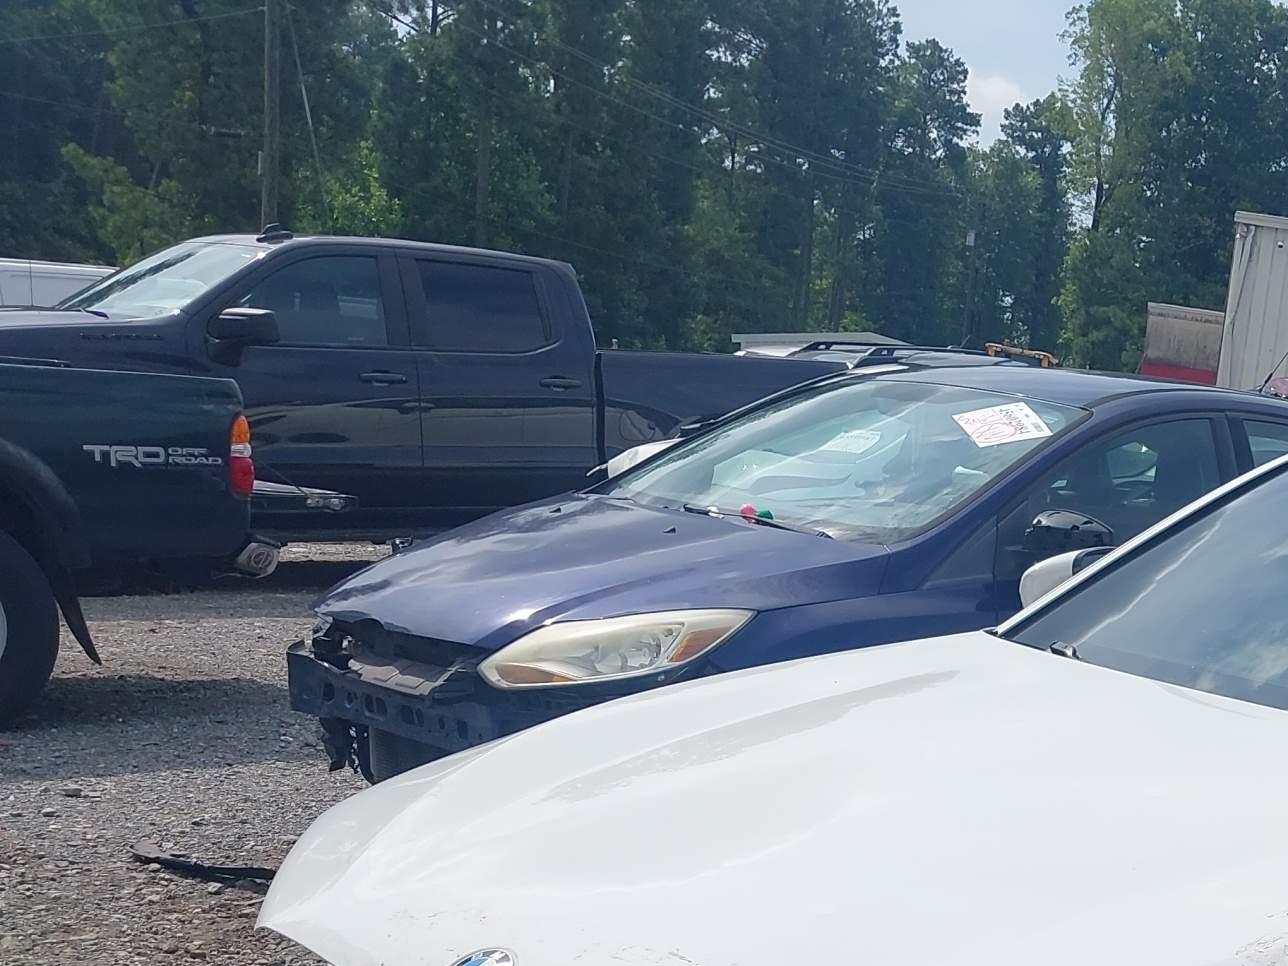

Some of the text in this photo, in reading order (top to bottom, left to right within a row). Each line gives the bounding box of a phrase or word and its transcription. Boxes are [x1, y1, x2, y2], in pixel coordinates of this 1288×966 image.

[82, 444, 165, 467] TRD
[167, 447, 208, 455] OFF
[167, 456, 222, 465] ROAD
